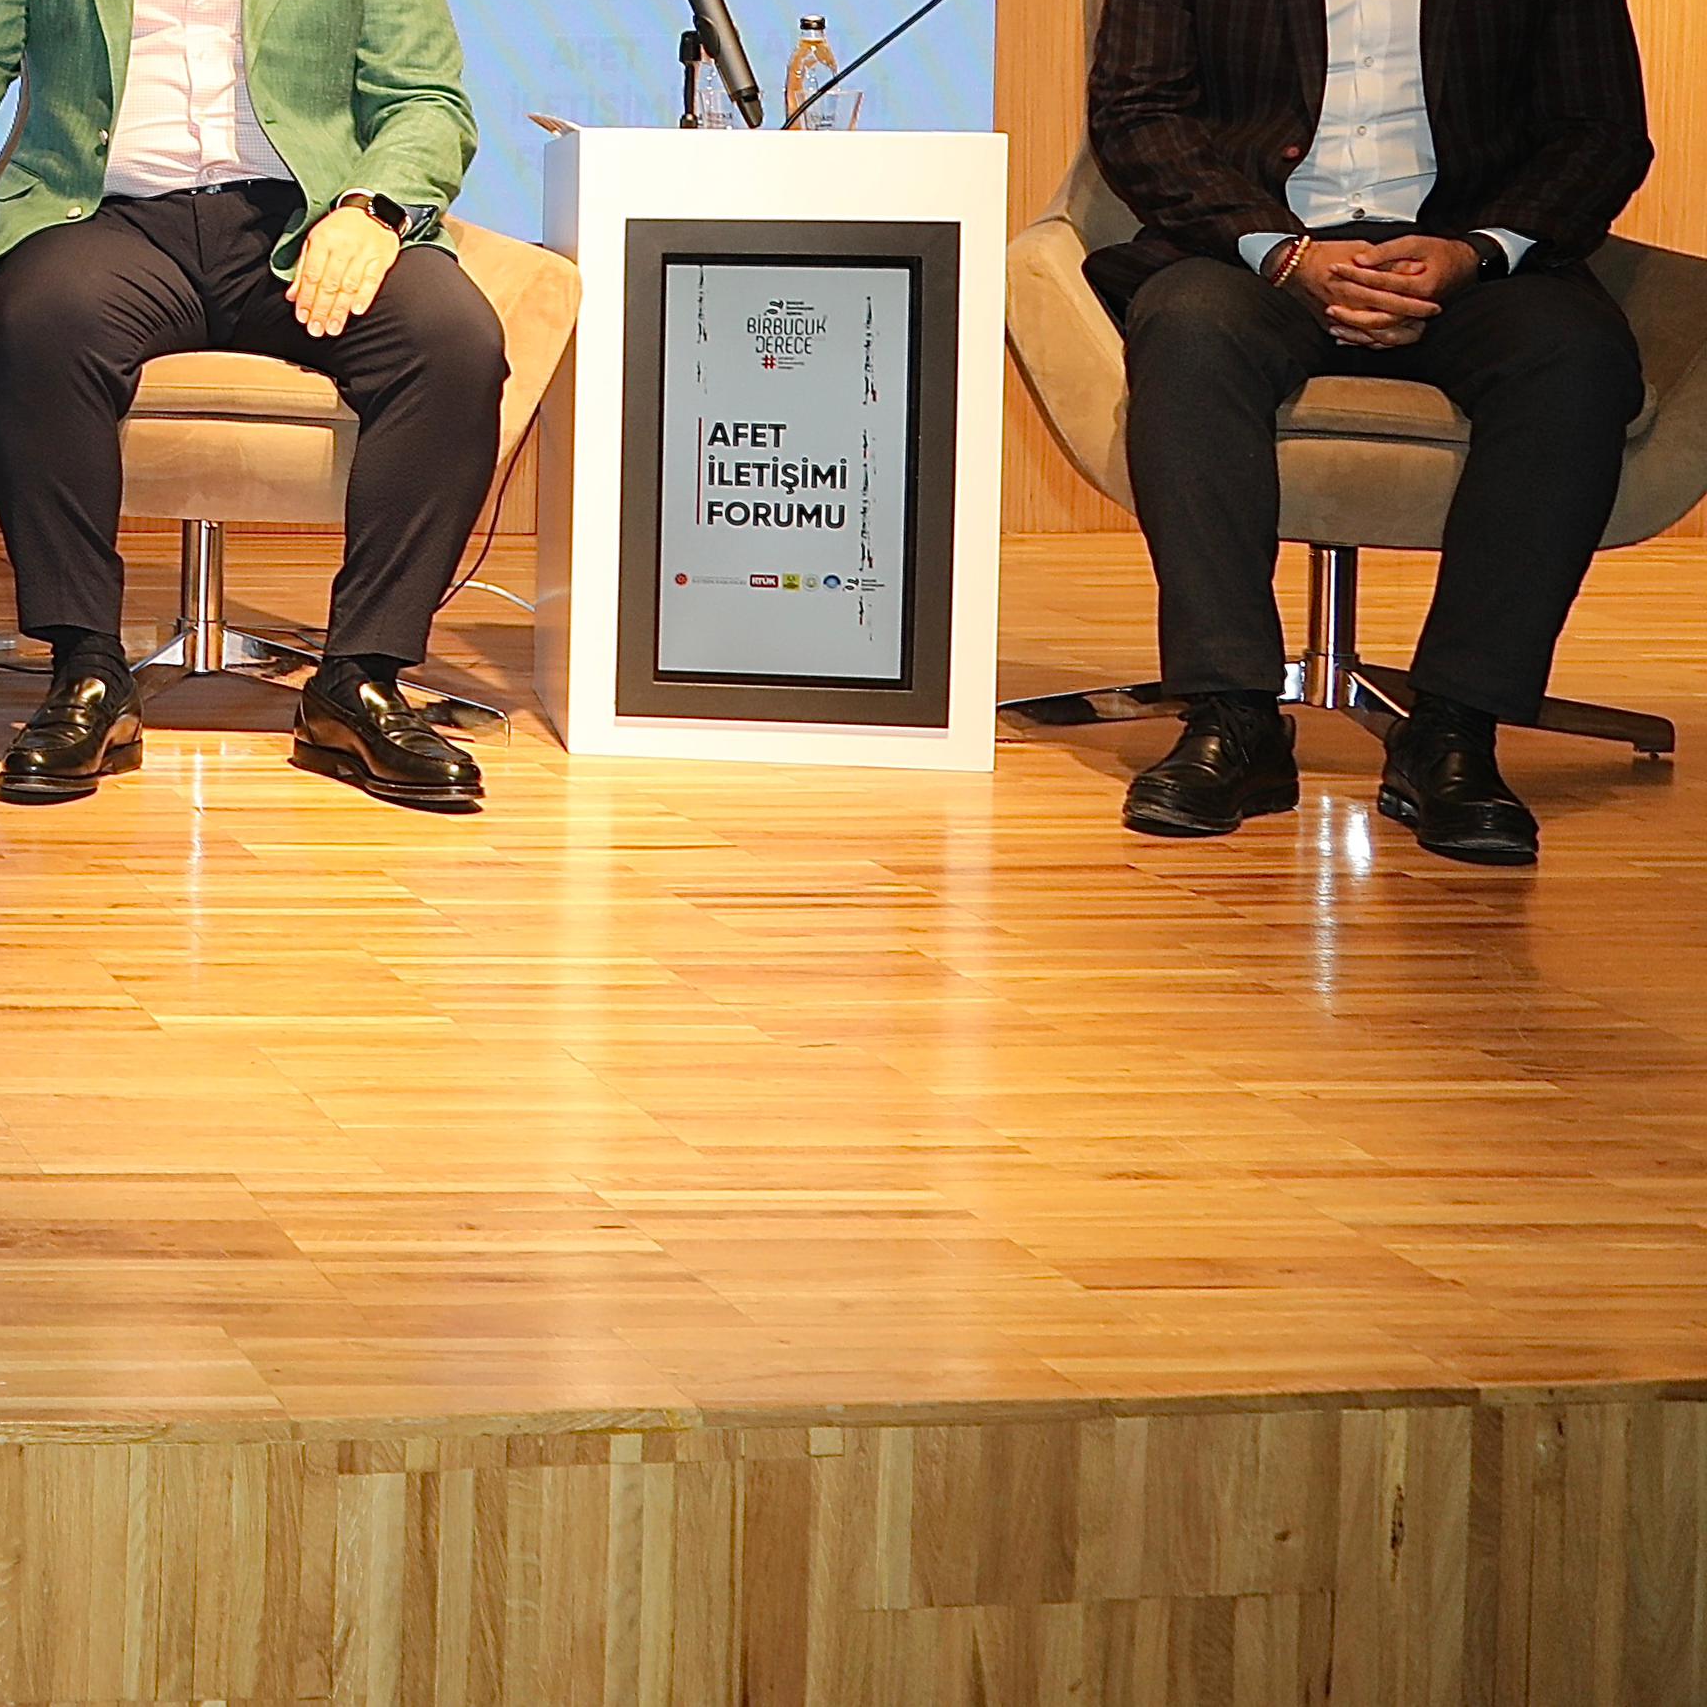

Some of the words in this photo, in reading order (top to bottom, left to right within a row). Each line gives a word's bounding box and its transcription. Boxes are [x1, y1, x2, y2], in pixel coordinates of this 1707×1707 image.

[707, 421, 787, 447] AFET
[708, 454, 847, 495] İLETİŞİMİ
[707, 500, 845, 529] FORUMU
